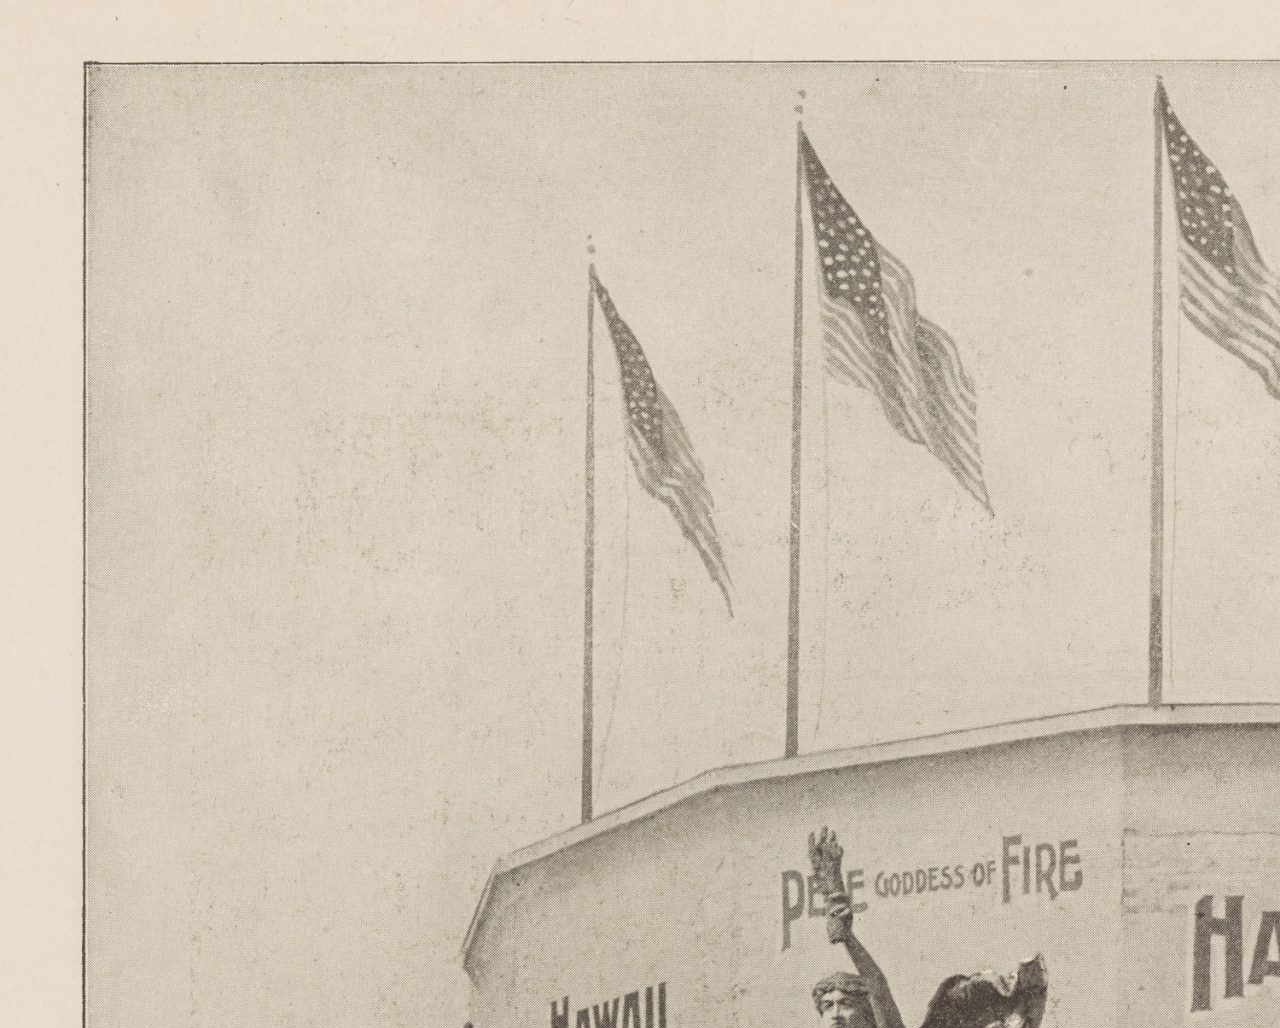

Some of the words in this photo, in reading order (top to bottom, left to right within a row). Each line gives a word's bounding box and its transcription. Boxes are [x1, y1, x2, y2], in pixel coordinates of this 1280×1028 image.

[781, 868, 869, 952] PEE
[874, 865, 965, 898] GODDESS
[969, 860, 996, 889] OF
[1002, 834, 1084, 904] FIRE
